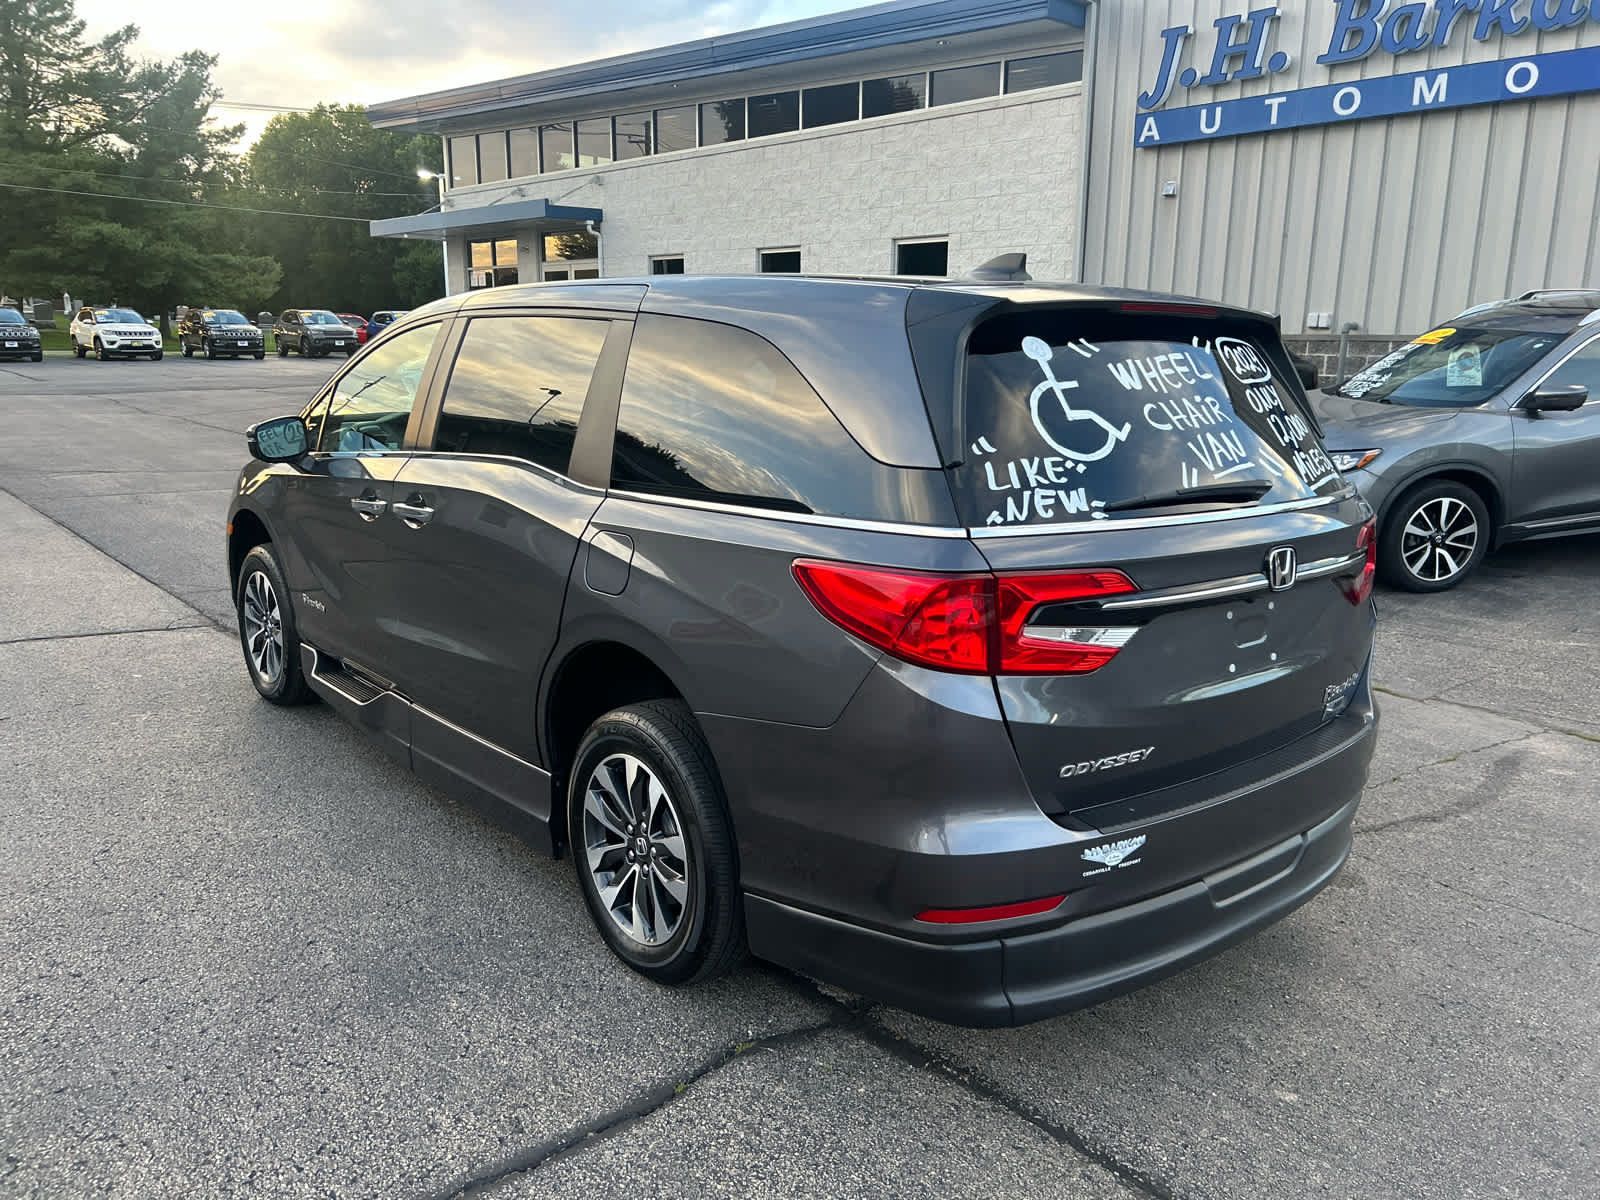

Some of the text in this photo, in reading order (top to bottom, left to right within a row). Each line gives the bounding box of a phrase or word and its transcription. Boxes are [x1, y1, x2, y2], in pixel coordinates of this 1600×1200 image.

[1138, 7, 1290, 109] J.H.
[1139, 61, 1540, 143] AUTOMO
[1107, 352, 1214, 393] WHEEL
[1245, 384, 1285, 413] ONLY
[1266, 414, 1309, 449] 12,000
[1187, 429, 1248, 472] VAN
[985, 456, 1068, 490] LIKE
[1006, 487, 1090, 522] NEW
[1060, 746, 1155, 778] ODYSSEY
